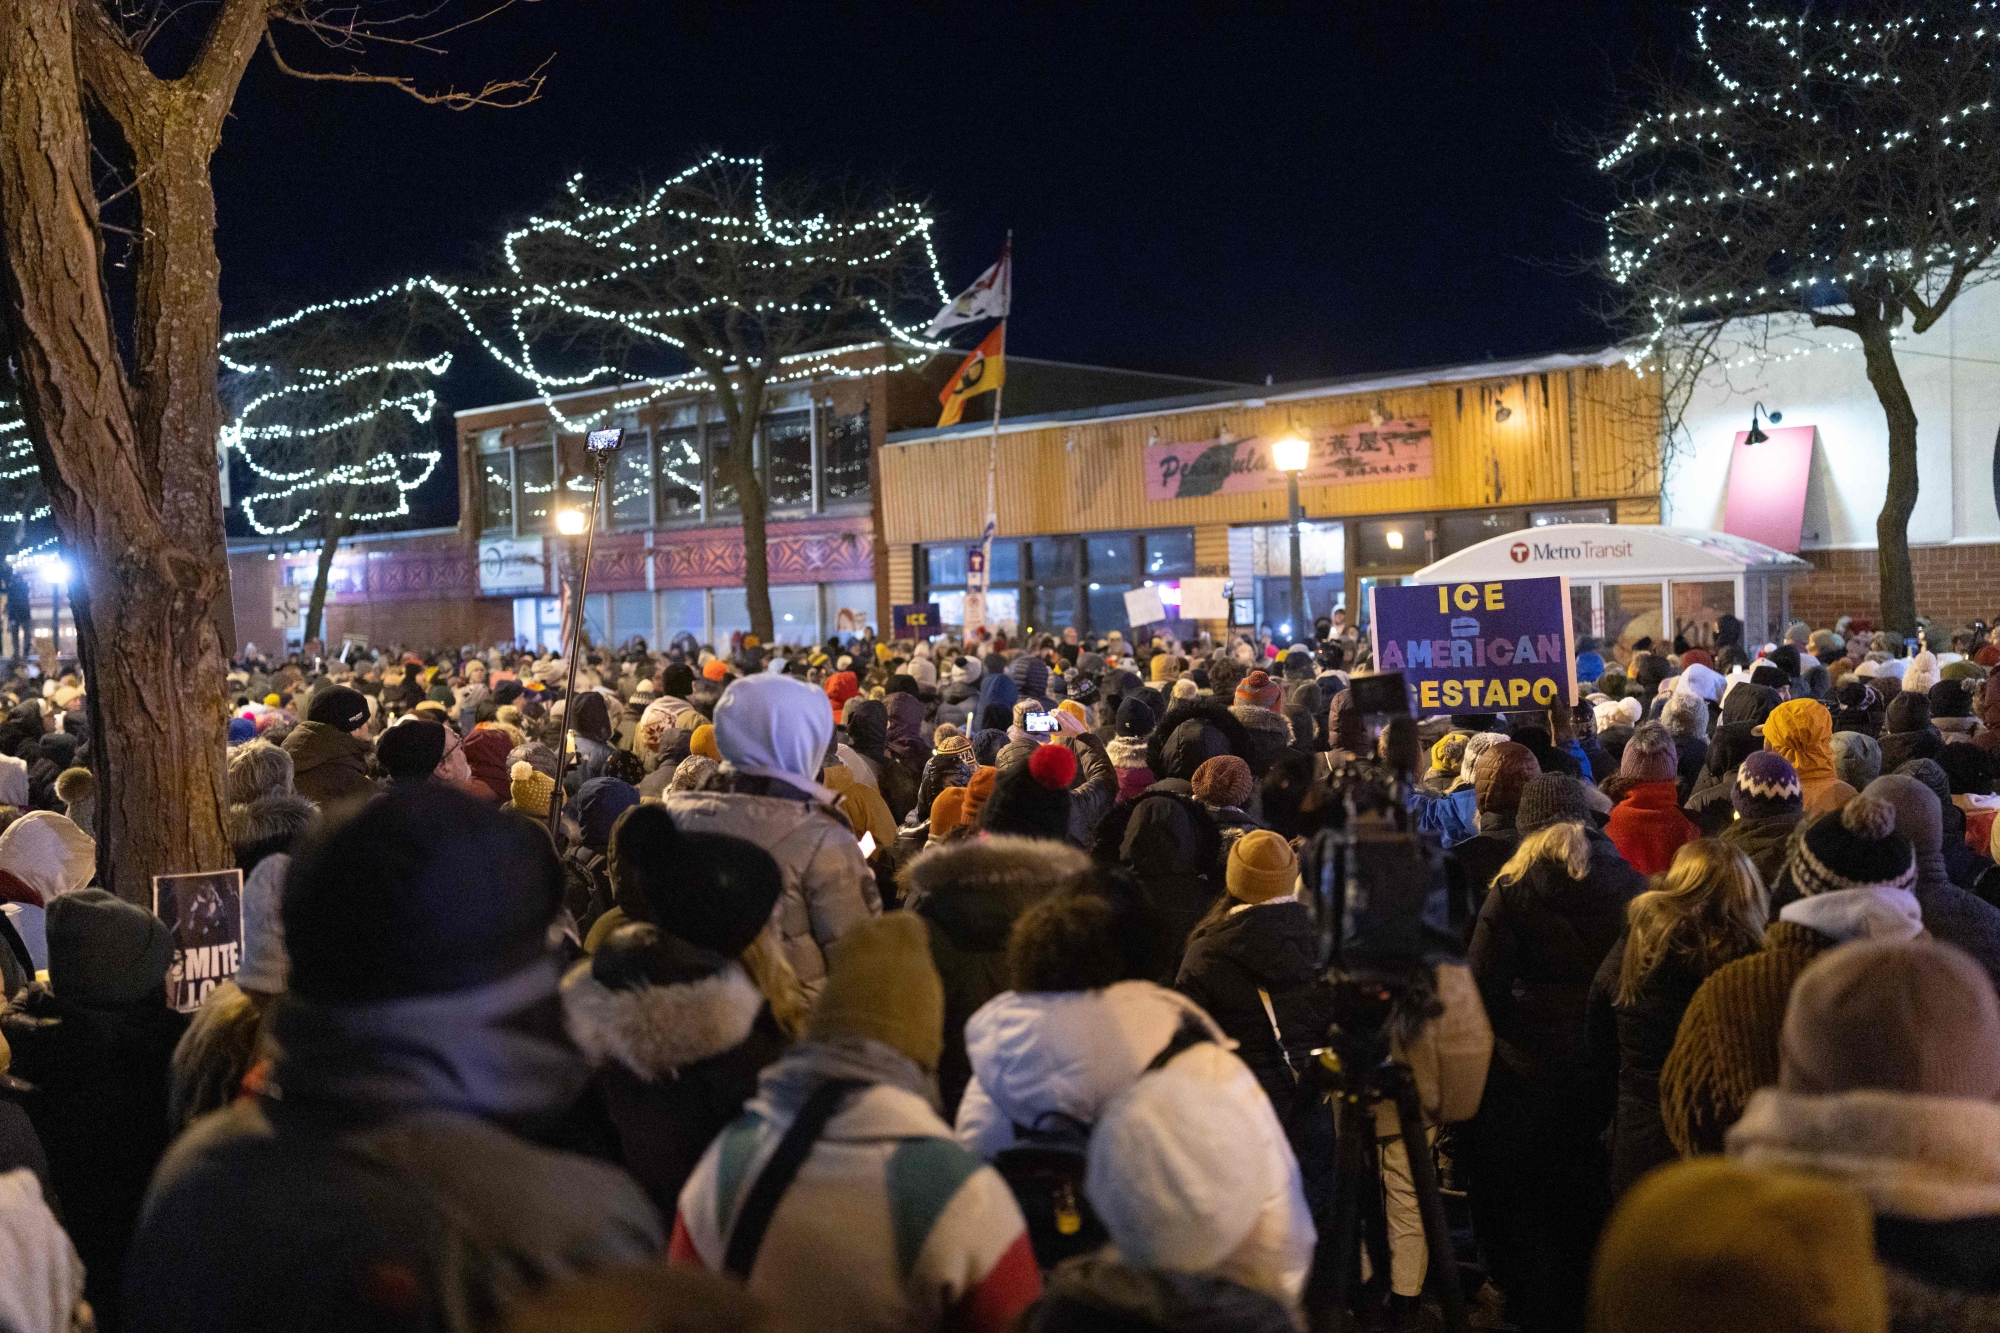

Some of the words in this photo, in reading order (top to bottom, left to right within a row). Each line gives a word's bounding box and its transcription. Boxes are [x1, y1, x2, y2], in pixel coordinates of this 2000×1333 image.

[1159, 446, 1268, 487] Peula
[1533, 543, 1581, 560] Metro
[1581, 540, 1634, 559] Transit
[1438, 582, 1505, 614] ICE
[1381, 633, 1561, 669] AMERICAN
